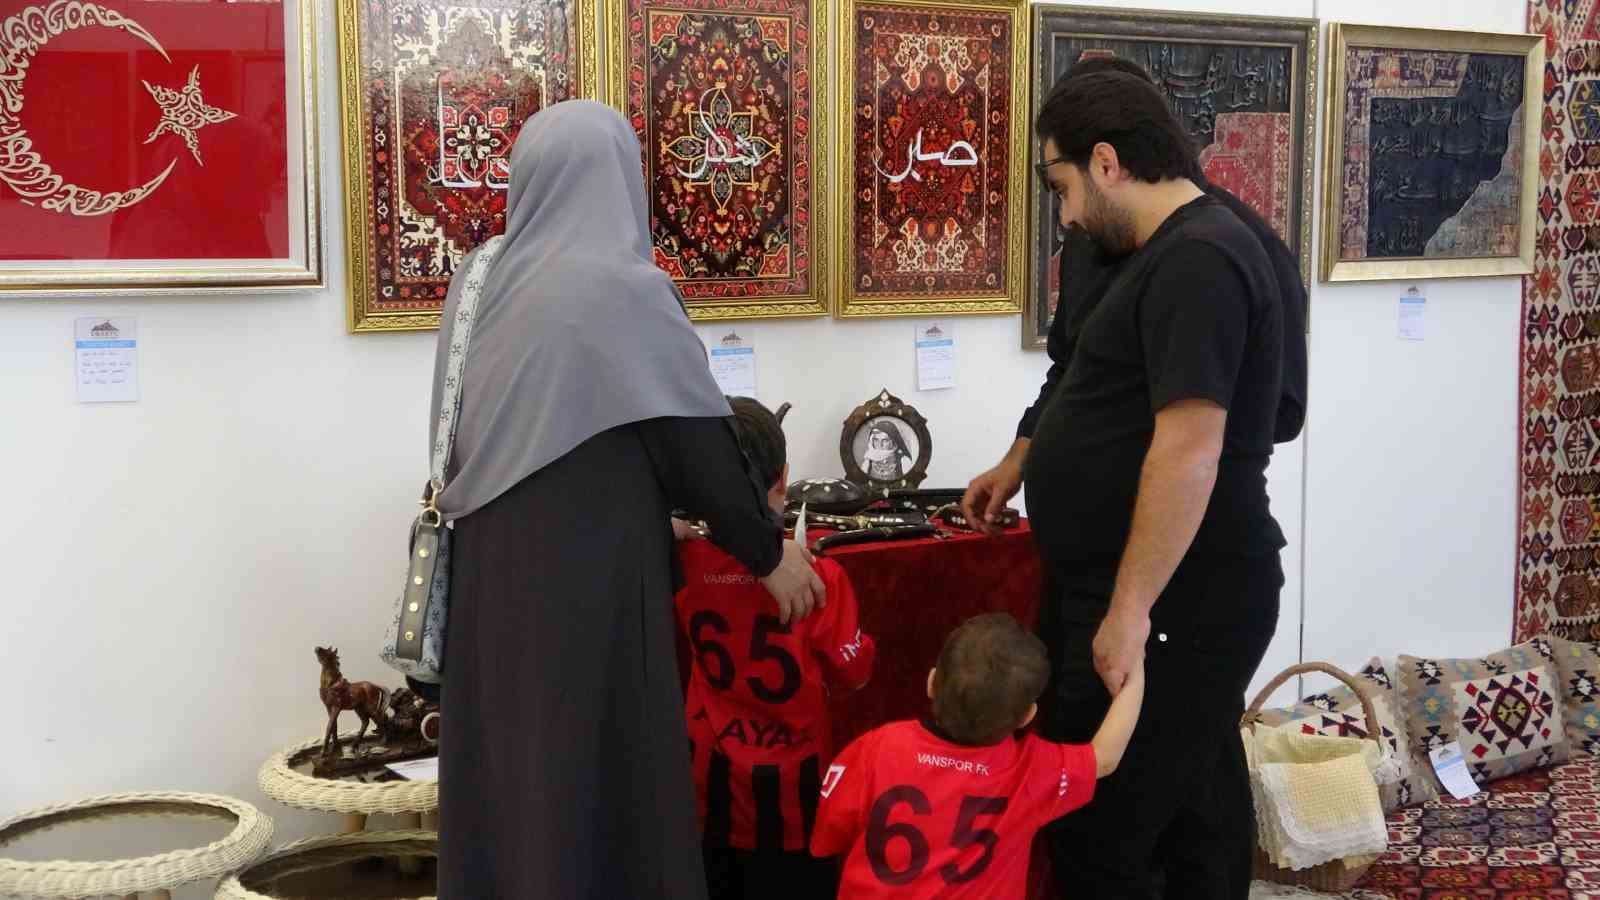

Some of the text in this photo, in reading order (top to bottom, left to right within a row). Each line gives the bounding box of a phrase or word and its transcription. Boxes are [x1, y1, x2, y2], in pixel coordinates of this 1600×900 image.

[703, 573, 754, 585] VANSPOR
[689, 610, 802, 704] 65
[917, 752, 990, 776] VANSPOR FK
[865, 784, 1009, 886] 65
